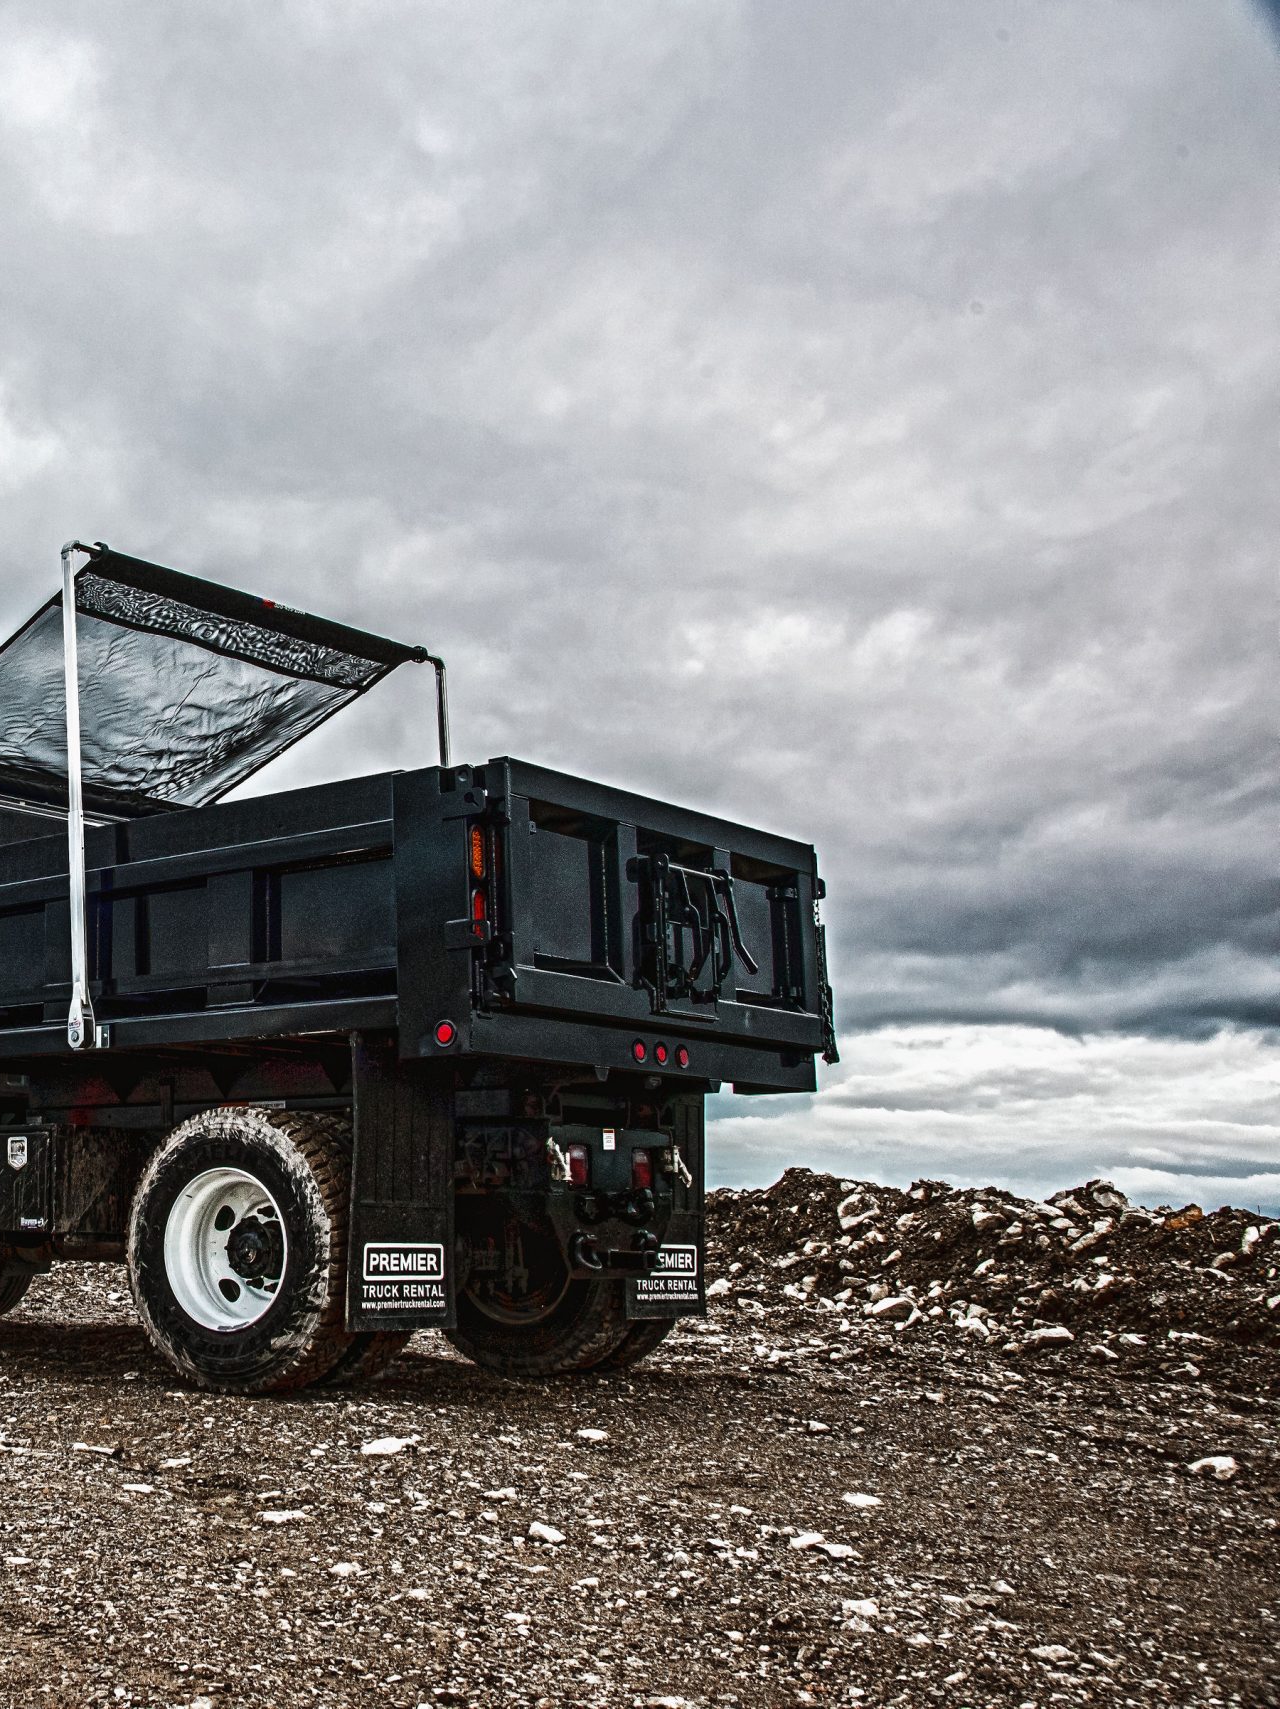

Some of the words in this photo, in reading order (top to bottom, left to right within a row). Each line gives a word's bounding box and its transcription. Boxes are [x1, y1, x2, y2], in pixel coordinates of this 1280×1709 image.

[369, 1253, 438, 1271] PREMIER
[656, 1252, 693, 1269] EMIER
[362, 1284, 400, 1298] TRUCK
[403, 1284, 445, 1297] RENTAL
[636, 1279, 666, 1291] TRUCK
[667, 1279, 698, 1291] RENTAL
[361, 1299, 446, 1311] www.premiertruckrental.com
